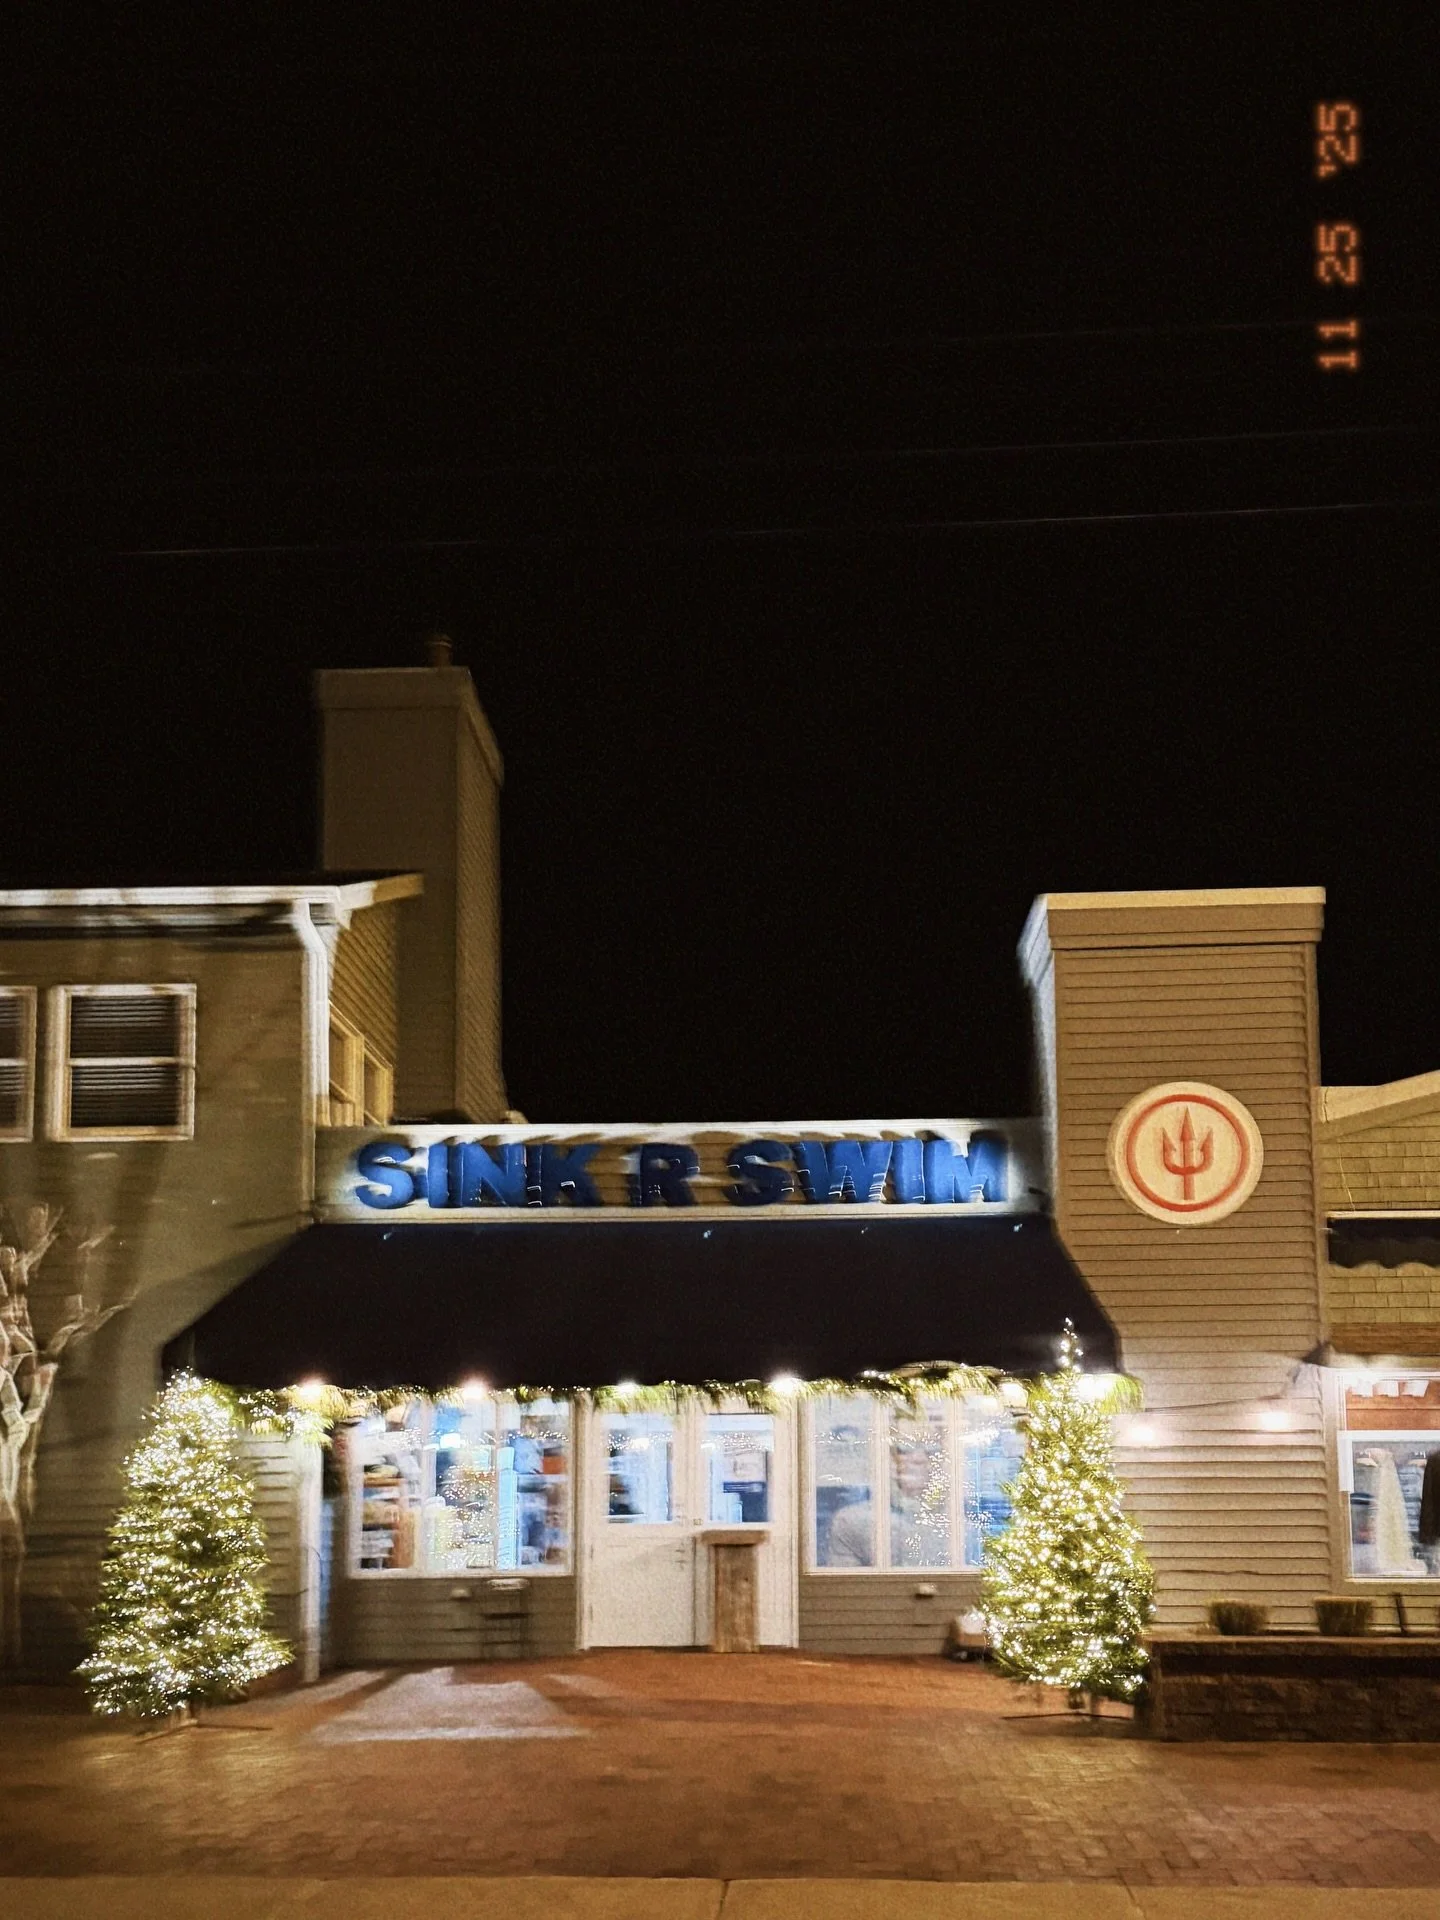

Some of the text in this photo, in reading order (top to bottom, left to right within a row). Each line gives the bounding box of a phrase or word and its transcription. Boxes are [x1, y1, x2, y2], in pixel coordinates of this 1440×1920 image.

[355, 1138, 1011, 1209] SINK R SWIM
